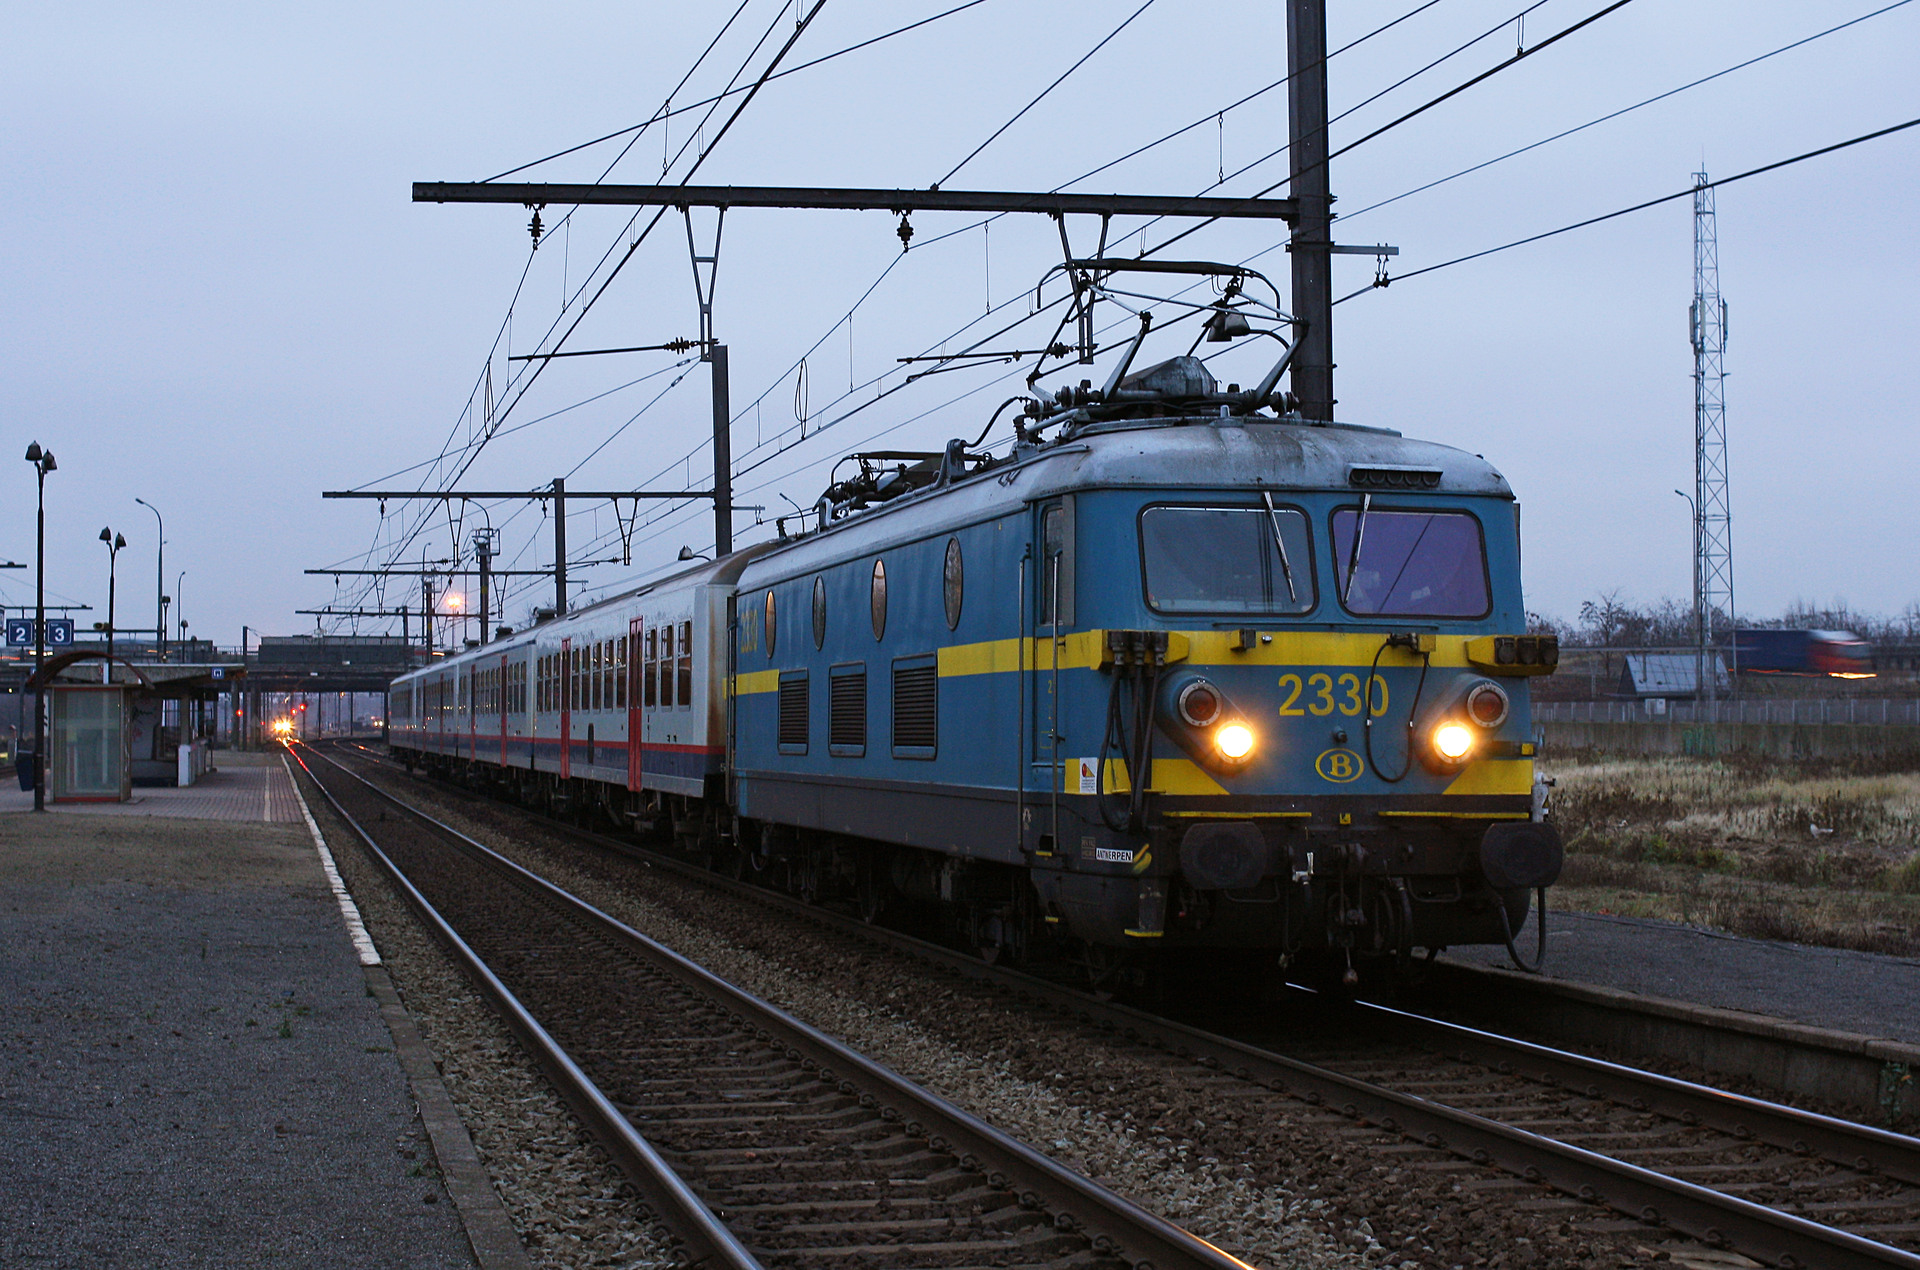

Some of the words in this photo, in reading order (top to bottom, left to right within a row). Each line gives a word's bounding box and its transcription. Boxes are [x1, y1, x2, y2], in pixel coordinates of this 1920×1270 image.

[15, 627, 26, 641] 2
[54, 627, 65, 642] 3
[1278, 672, 1389, 717] 2330
[1329, 753, 1353, 778] B
[1097, 849, 1132, 861] ANTWERPEN
